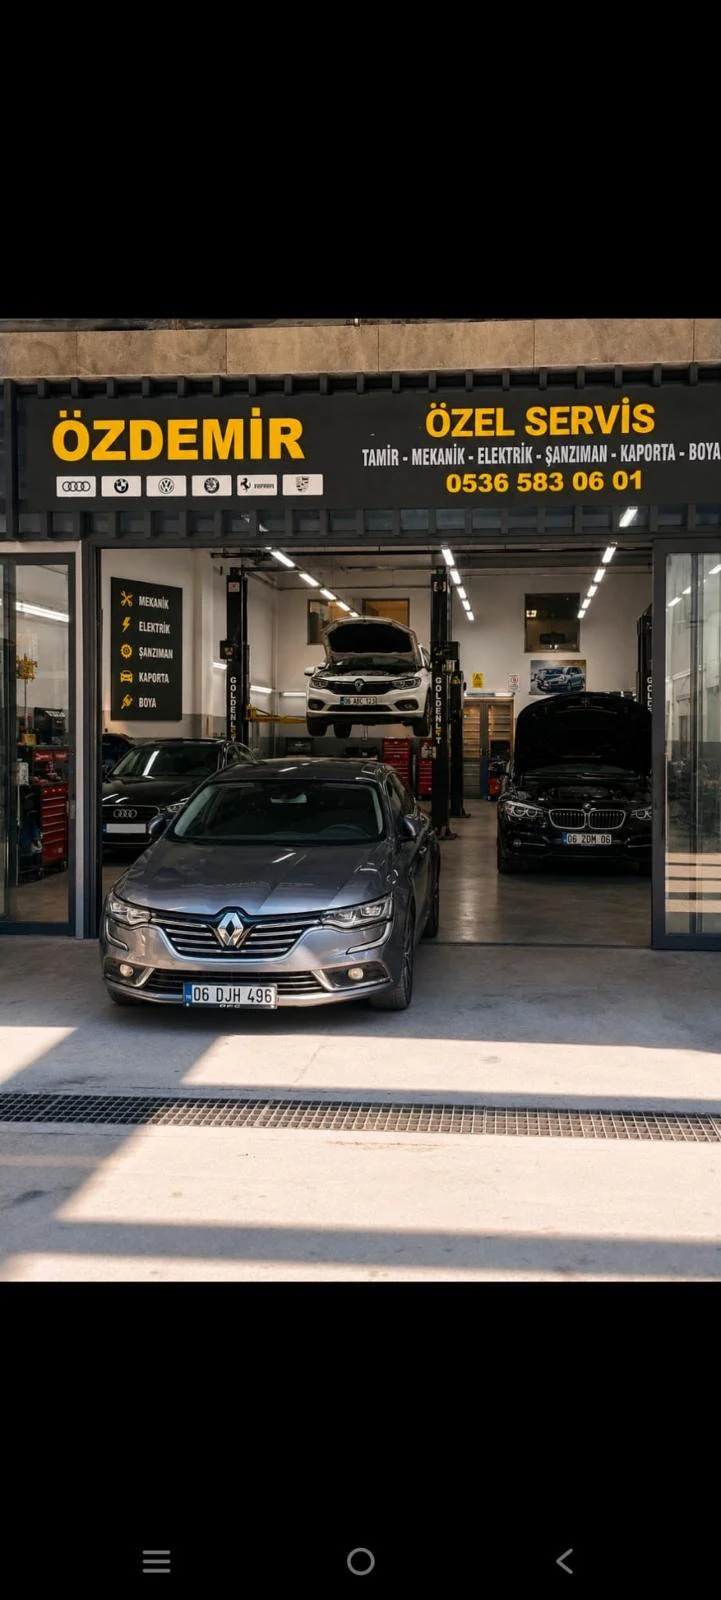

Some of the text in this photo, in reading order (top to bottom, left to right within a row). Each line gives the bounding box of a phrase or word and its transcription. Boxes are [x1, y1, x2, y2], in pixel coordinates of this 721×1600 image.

[425, 397, 655, 438] ÖZEL SERVİS
[52, 407, 305, 462] ÖZDEMİR
[362, 444, 399, 467] TAMİR
[411, 443, 465, 466] MEKANİK
[477, 442, 533, 465] ELEKTRİK
[545, 445, 608, 467] ŞANZIMAN
[620, 443, 676, 462] KAPORTA
[689, 442, 721, 461] BOYA
[446, 470, 642, 493] 0536 583 06 01
[138, 594, 170, 610] MEKANİK
[138, 620, 171, 635] ELEKTRİK
[138, 646, 174, 660] ŞANZIMAN
[138, 671, 170, 684] KAPORTA
[138, 697, 157, 709] BOYA
[567, 834, 578, 843] 06
[600, 835, 611, 844] 06
[193, 986, 272, 1004] 06 DJH 496
